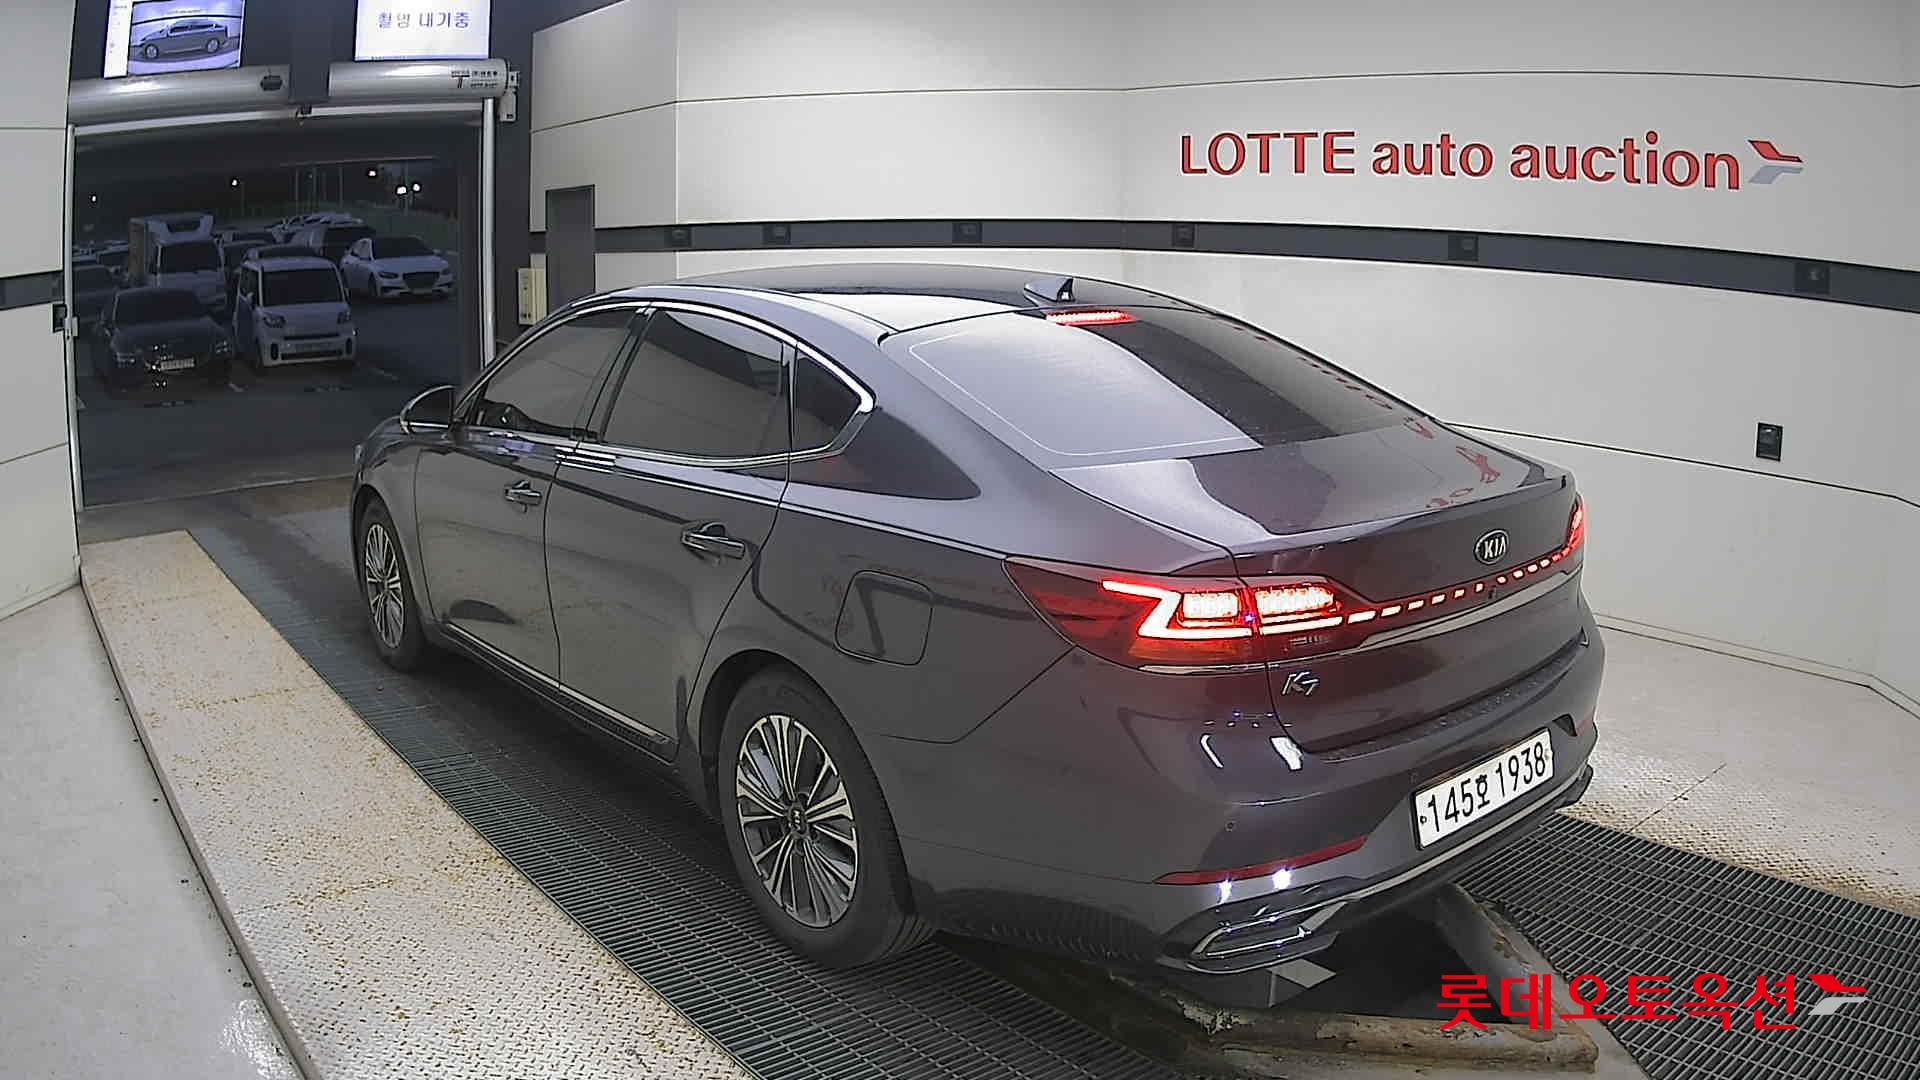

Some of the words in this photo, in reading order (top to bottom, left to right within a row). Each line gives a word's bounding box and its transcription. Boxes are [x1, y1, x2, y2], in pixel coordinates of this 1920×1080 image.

[418, 12, 471, 29] 대기중
[1180, 131, 1356, 175] LOTTE
[1371, 133, 1495, 178] auto
[1509, 130, 1740, 190] auction
[1482, 535, 1507, 561] KIA
[1281, 670, 1321, 696] K7
[1427, 774, 1491, 833] 145호
[1495, 741, 1546, 798] 1938
